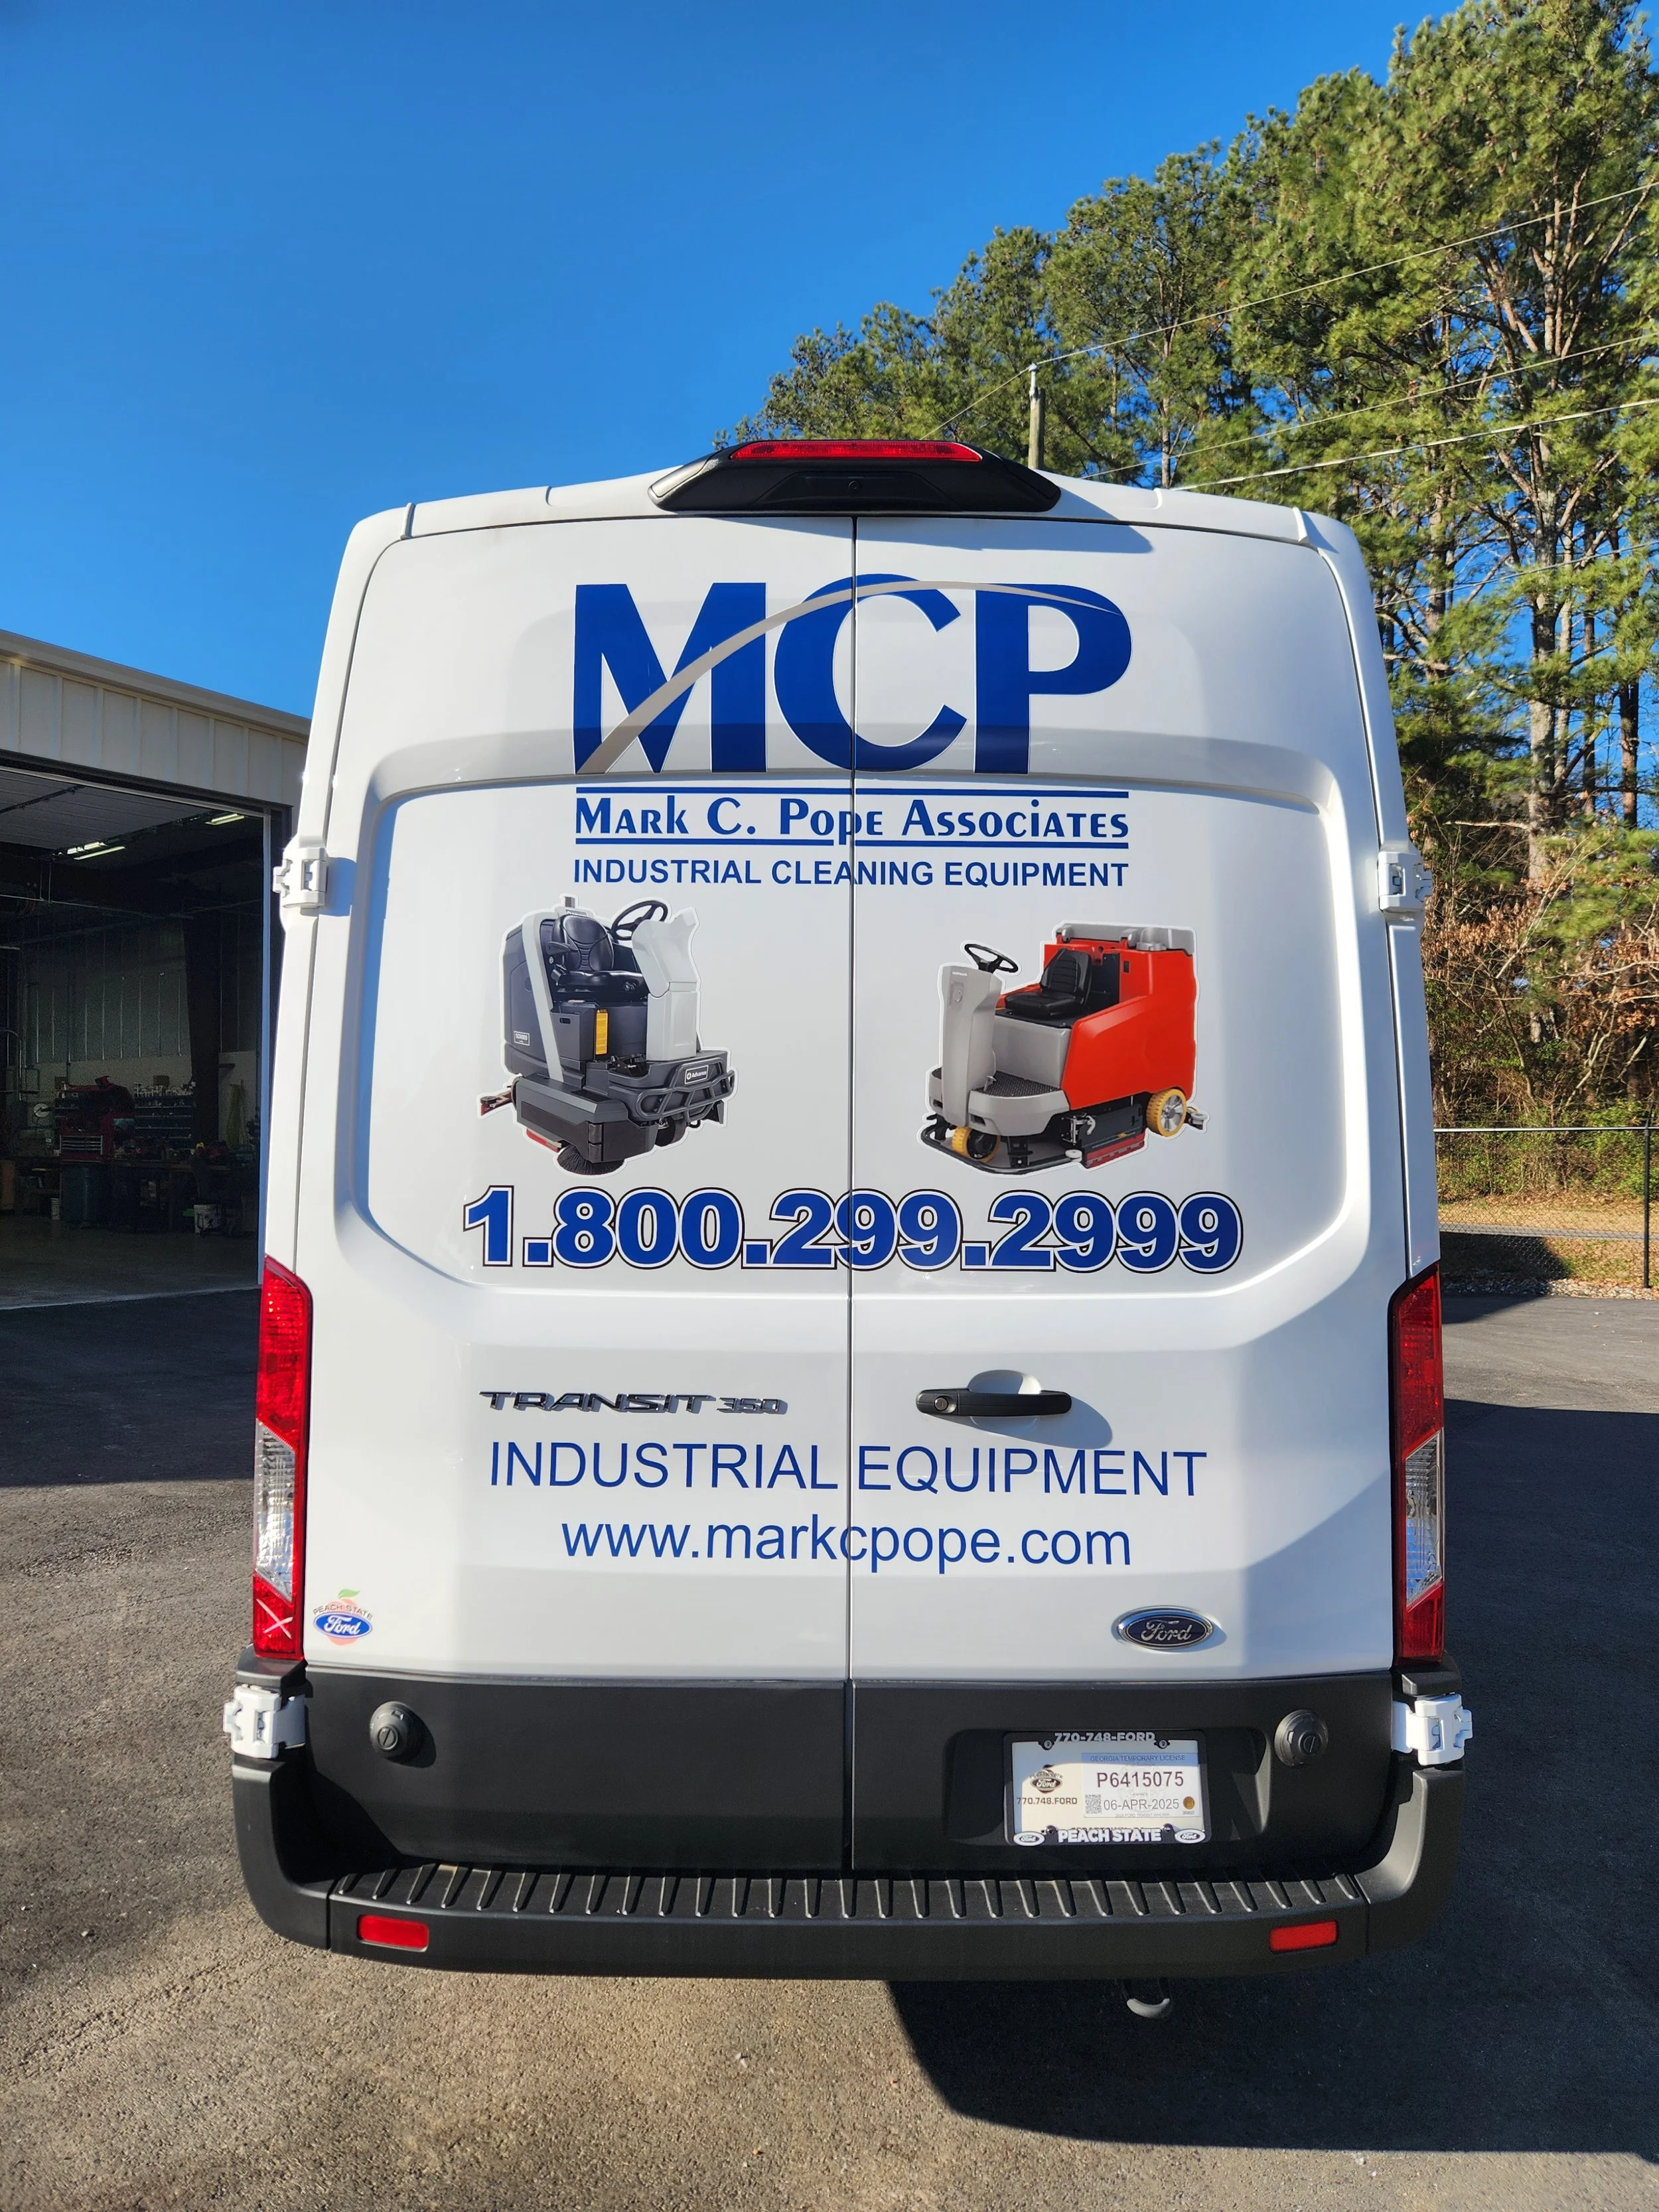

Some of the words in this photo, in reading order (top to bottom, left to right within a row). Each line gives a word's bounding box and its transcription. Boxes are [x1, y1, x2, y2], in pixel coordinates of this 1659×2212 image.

[573, 573, 1132, 774] MCP
[707, 797, 756, 834] C.
[574, 859, 761, 884] INDUSTRIAL
[771, 859, 934, 886] CLEANING
[944, 861, 1129, 887] EQUIPMENT
[464, 1186, 1244, 1272] 1.800.299.2999
[479, 1392, 717, 1413] TRANSIT
[717, 1397, 781, 1414] 350
[492, 1441, 838, 1489] INDUSTRIAL
[858, 1445, 1206, 1496] EQUIPMENT
[562, 1513, 1130, 1575] www.markcpope.com
[313, 1604, 342, 1615] PEACH
[346, 1605, 374, 1621] STATE
[324, 1615, 361, 1635] Ford
[1141, 1619, 1192, 1641] Ford
[1054, 1732, 1155, 1743] 770-748-FORD
[1036, 1778, 1057, 1788] Ford
[1096, 1771, 1185, 1788] P6415075
[1103, 1799, 1179, 1810] 06-APR-2025
[1058, 1828, 1111, 1843] PEACH
[1112, 1827, 1162, 1842] STATE
